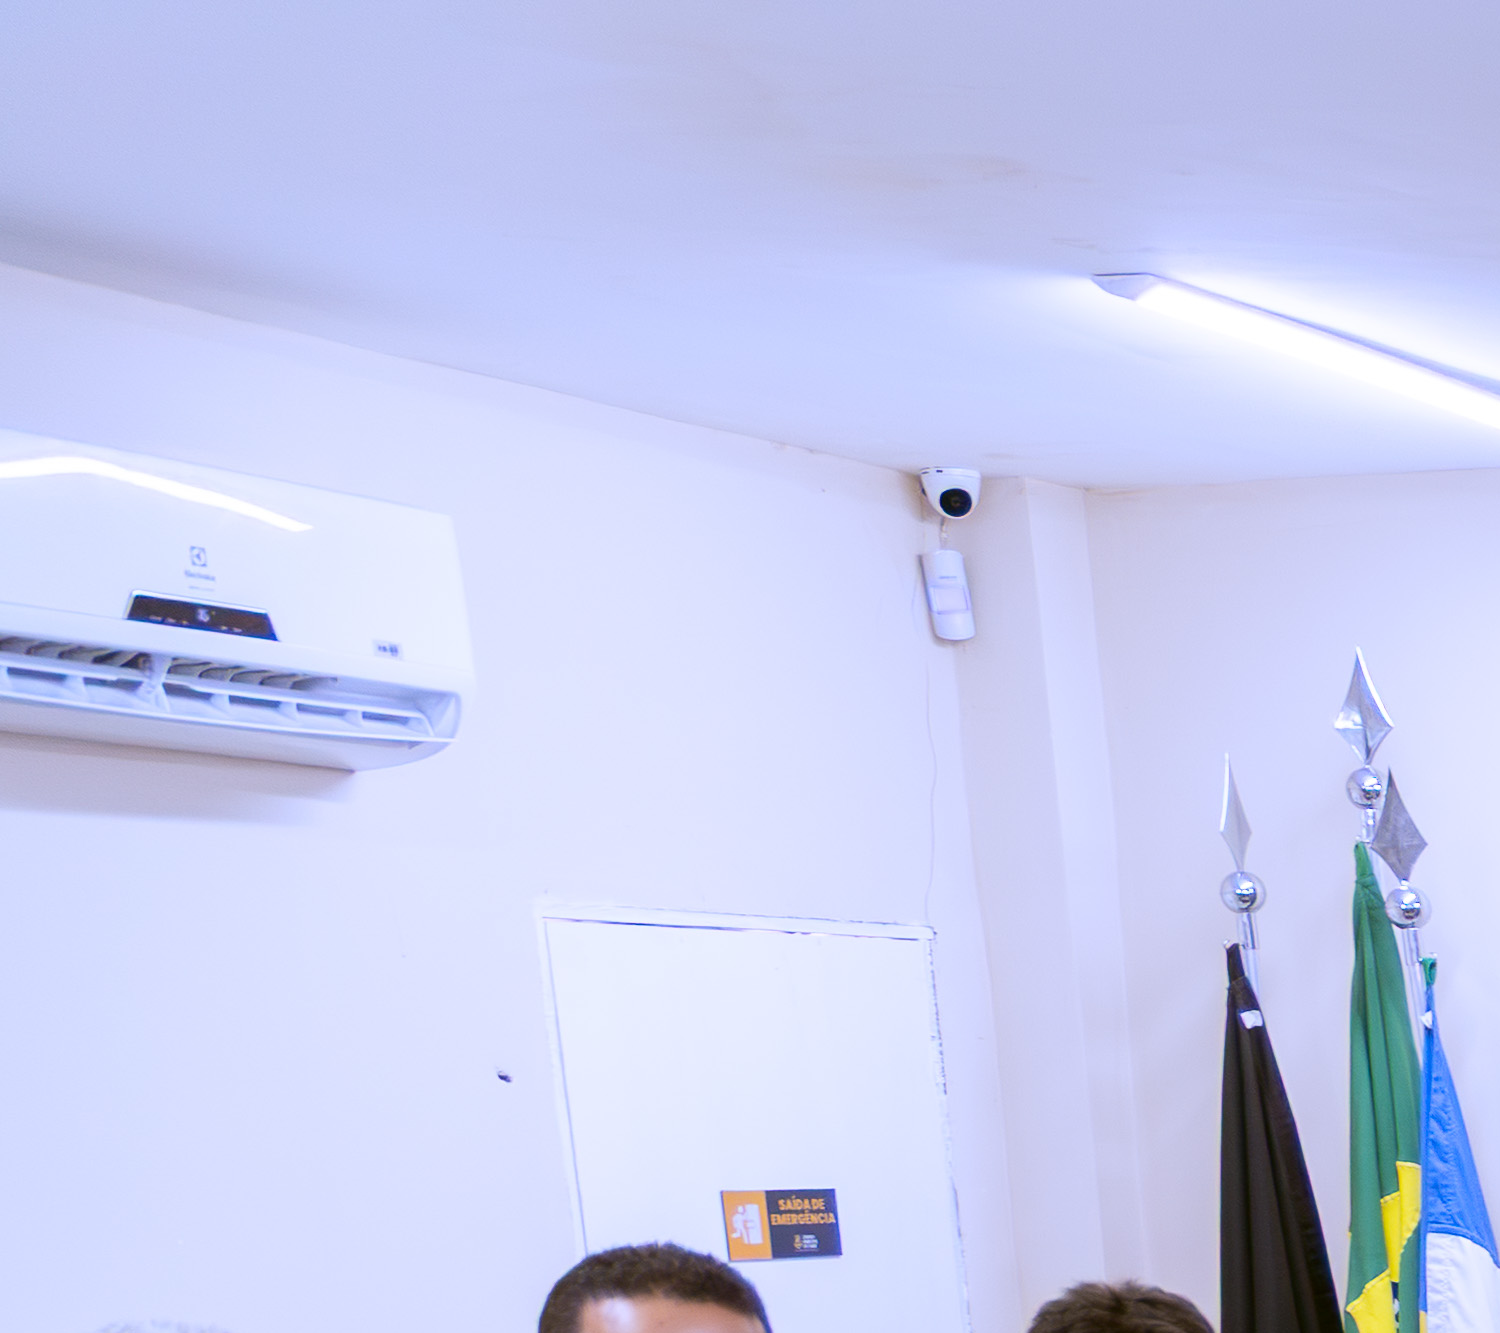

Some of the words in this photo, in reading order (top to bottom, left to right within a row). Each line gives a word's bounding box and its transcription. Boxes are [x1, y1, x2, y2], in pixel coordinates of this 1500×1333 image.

[778, 1195, 811, 1211] SAÍDA
[811, 1198, 826, 1210] DE
[770, 1210, 836, 1226] EMERGÊNCIA
